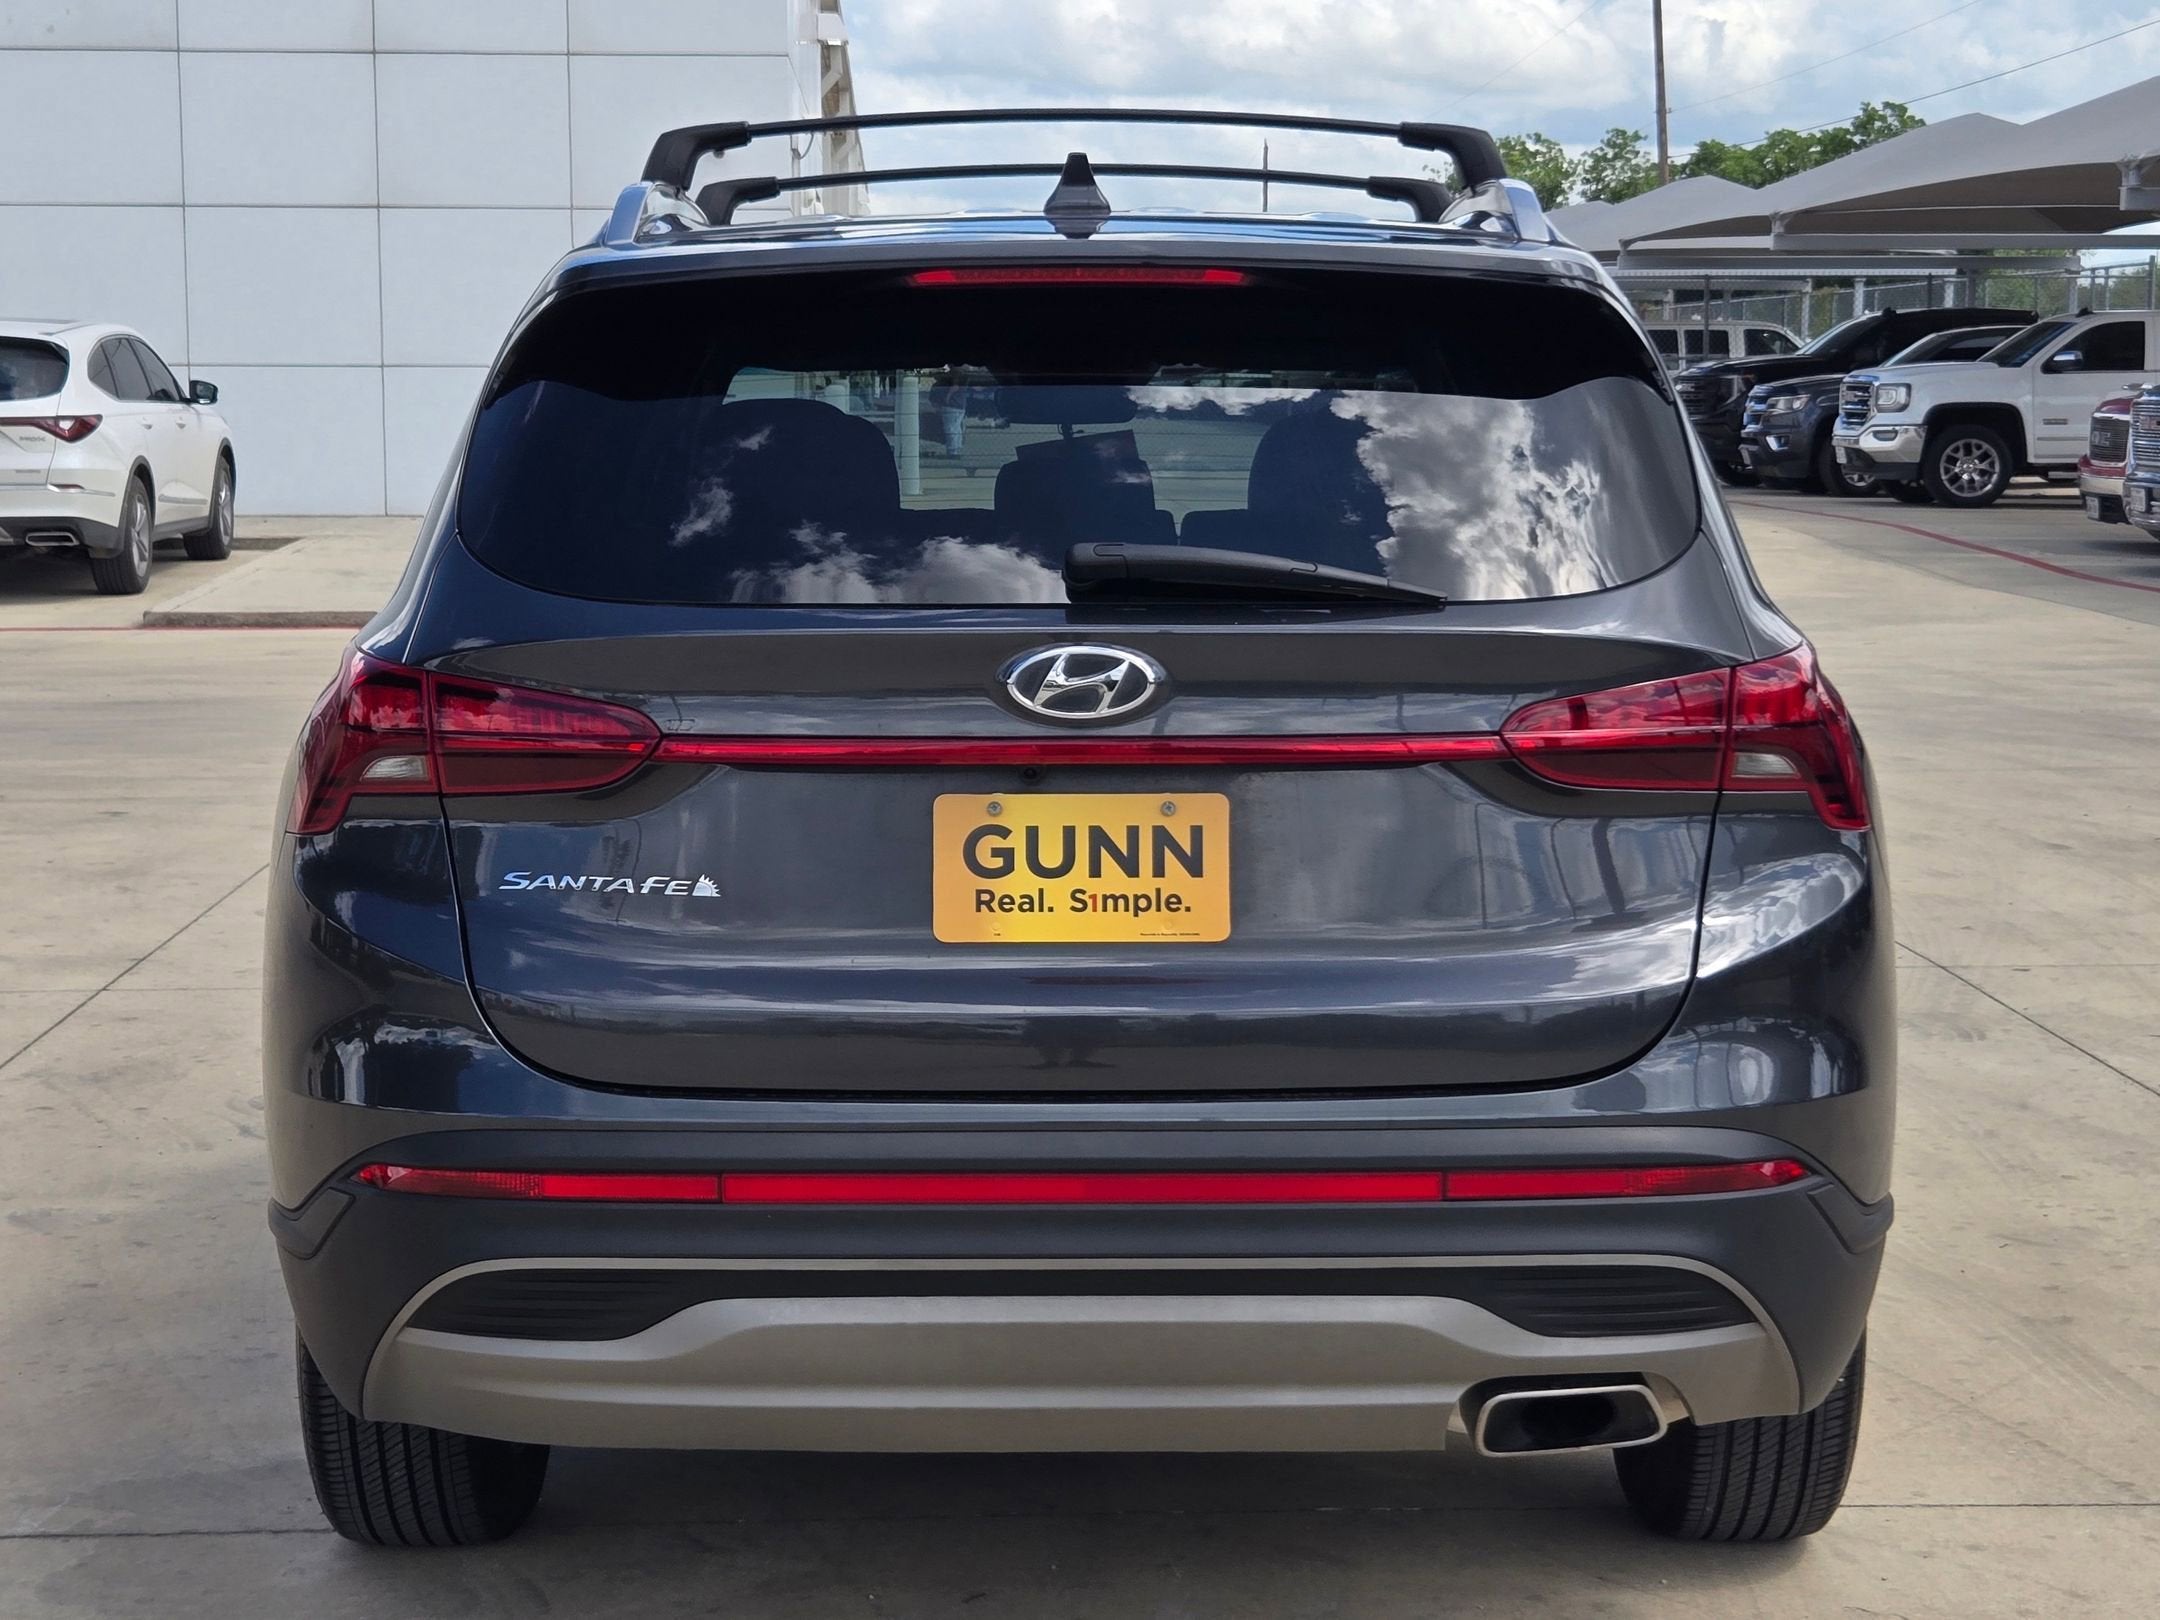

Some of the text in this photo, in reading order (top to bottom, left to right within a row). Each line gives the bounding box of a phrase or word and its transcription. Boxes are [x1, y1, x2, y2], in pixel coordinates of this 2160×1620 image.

[962, 823, 1204, 880] GUNN
[974, 887, 1192, 918] Real. S1mple.
